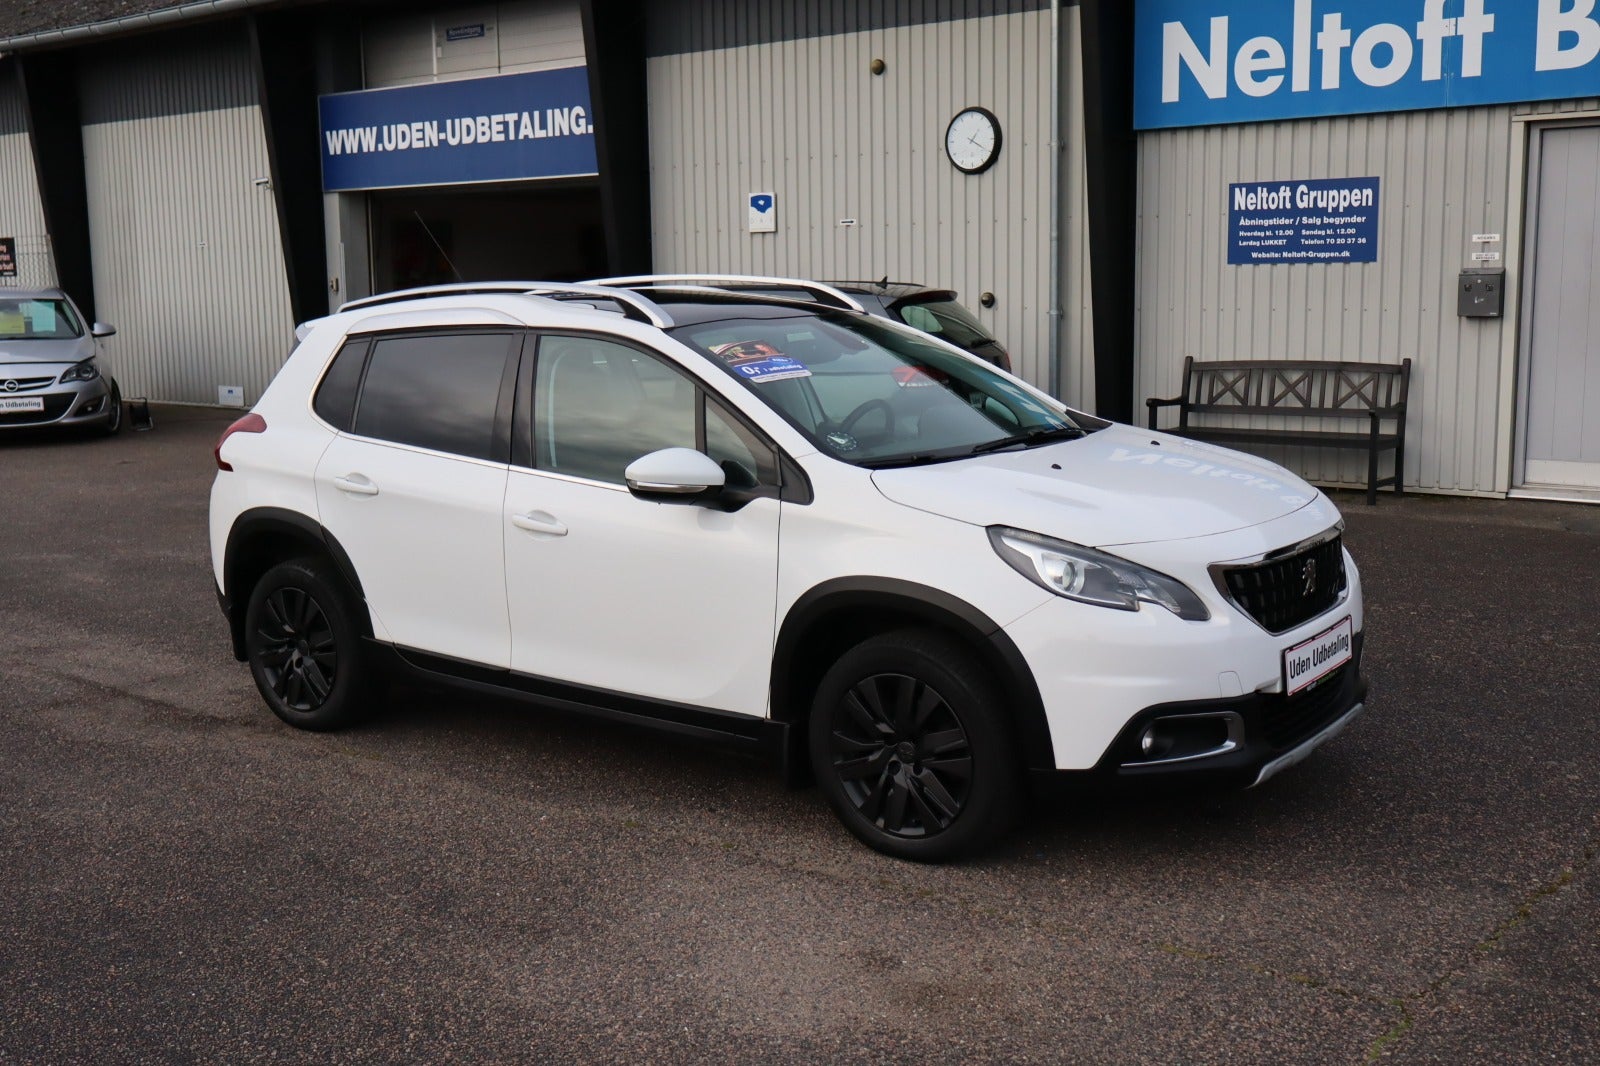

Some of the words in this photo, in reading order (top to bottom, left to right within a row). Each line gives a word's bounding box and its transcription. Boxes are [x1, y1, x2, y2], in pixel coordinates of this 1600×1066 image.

[1162, 0, 1495, 103] Neltoft
[326, 106, 593, 155] WWW.UDEN-UDBETALING.
[1234, 185, 1291, 211] Neltoft
[1296, 184, 1373, 213] Gruppen
[1239, 216, 1294, 227] Åbningstider
[1301, 216, 1321, 226] Salg
[1323, 214, 1366, 225] begynder
[1251, 251, 1281, 259] Website:
[1282, 250, 1351, 259] Neltoft-Gruppen.dk
[1289, 656, 1311, 679] Uden
[1312, 633, 1349, 667] Udbetaling
